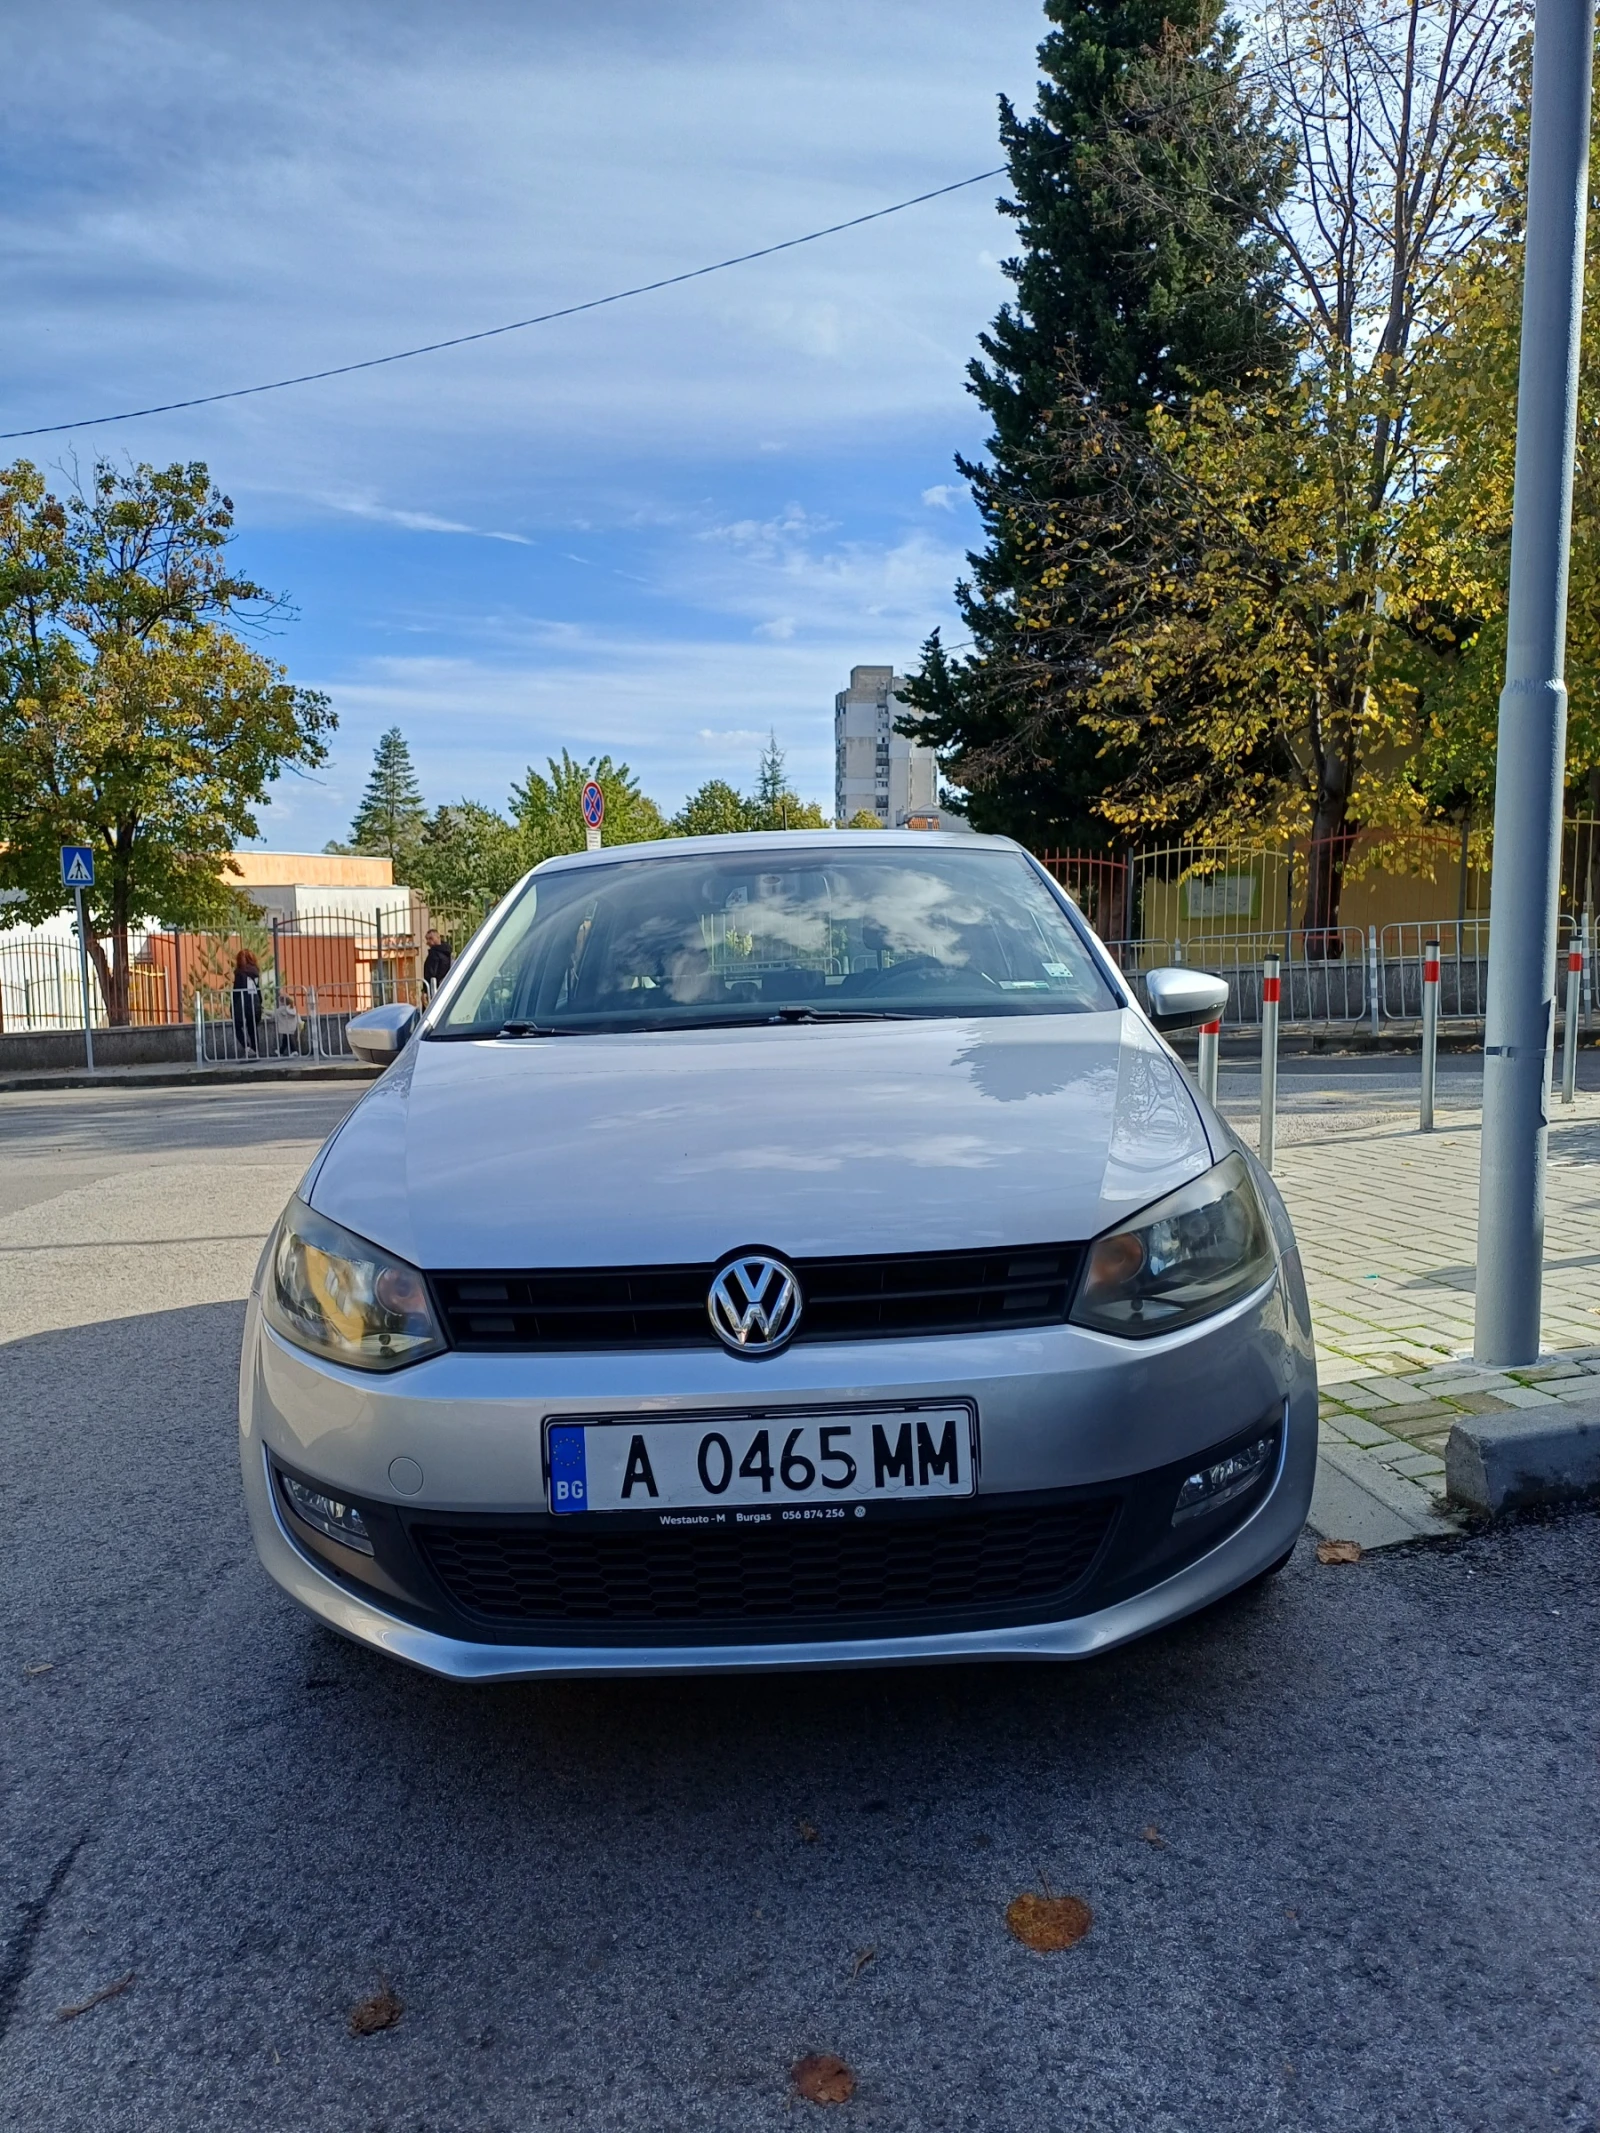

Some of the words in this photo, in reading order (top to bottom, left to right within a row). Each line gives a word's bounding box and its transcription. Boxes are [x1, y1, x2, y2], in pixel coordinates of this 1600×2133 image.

[620, 1433, 660, 1499] A
[697, 1425, 857, 1495] 0465
[871, 1419, 959, 1489] MM
[556, 1480, 584, 1500] BG
[735, 1512, 772, 1523] Burgas
[781, 1510, 801, 1520] 056
[803, 1509, 823, 1519] 874
[825, 1508, 845, 1518] 256
